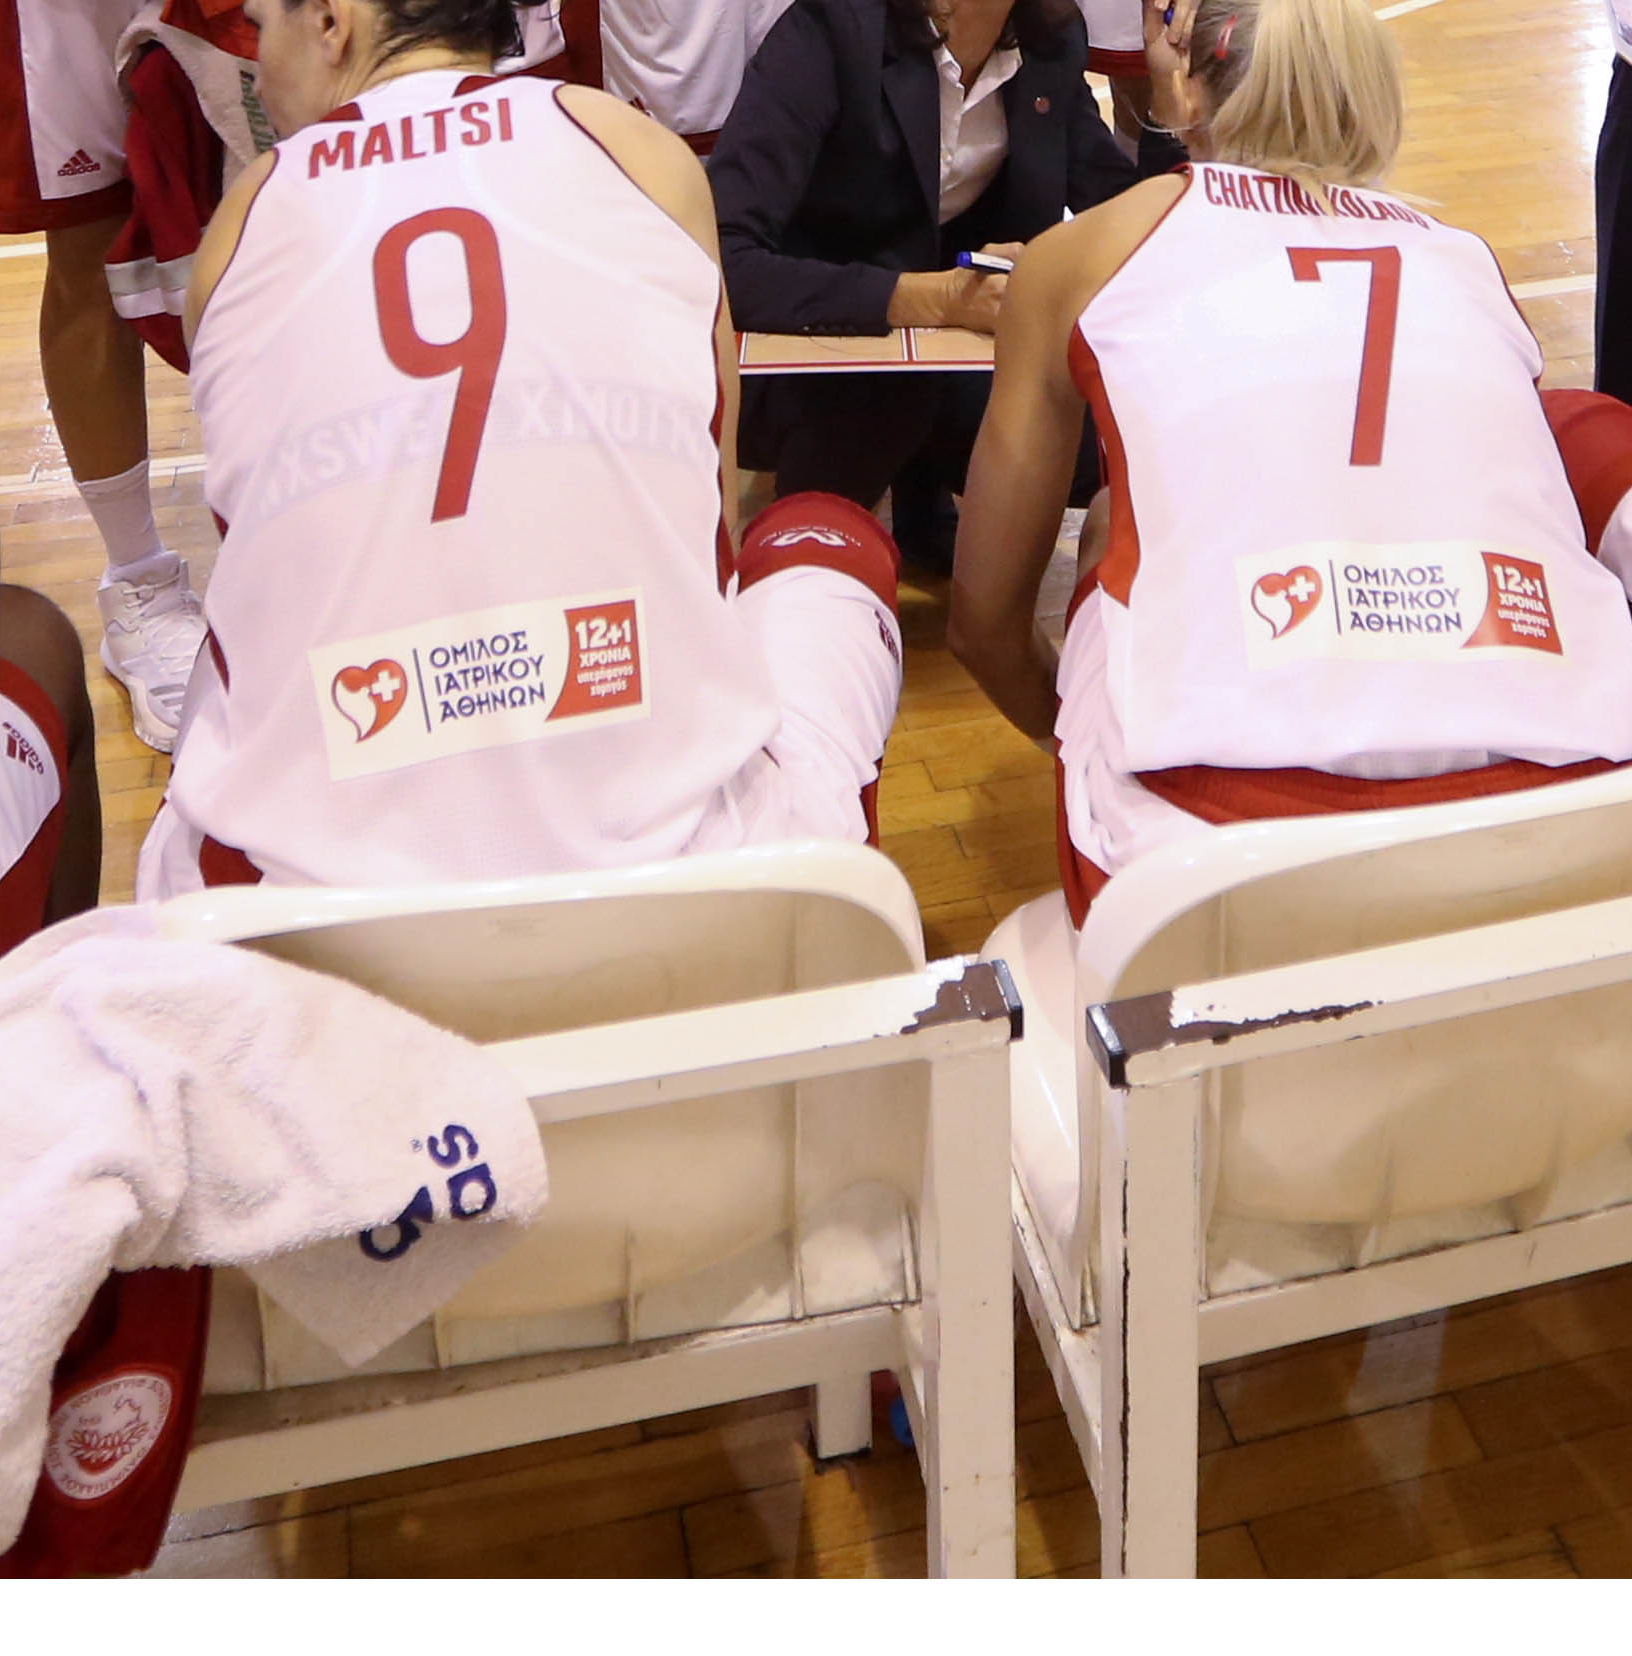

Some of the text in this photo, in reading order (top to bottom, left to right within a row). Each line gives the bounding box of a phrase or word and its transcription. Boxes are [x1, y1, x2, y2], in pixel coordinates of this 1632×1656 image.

[308, 98, 513, 179] MALTSI
[58, 162, 100, 176] adidas
[373, 207, 507, 523] 9
[1286, 246, 1402, 466] 7
[1344, 564, 1444, 585] ΟΜΙΛΟΣ
[1493, 565, 1544, 598] 12+1
[1348, 587, 1460, 609] ΙΑΤΡΙΚΟΥ
[575, 618, 632, 650] 12+1
[1350, 611, 1462, 633] ΑΘΗΝΩΝ
[430, 630, 528, 668] ΟΜΙΛΟΣ
[435, 655, 544, 696] ΙΑΤΡΙΚΟΥ
[439, 682, 545, 723] ΑΘΗΝΩΝ
